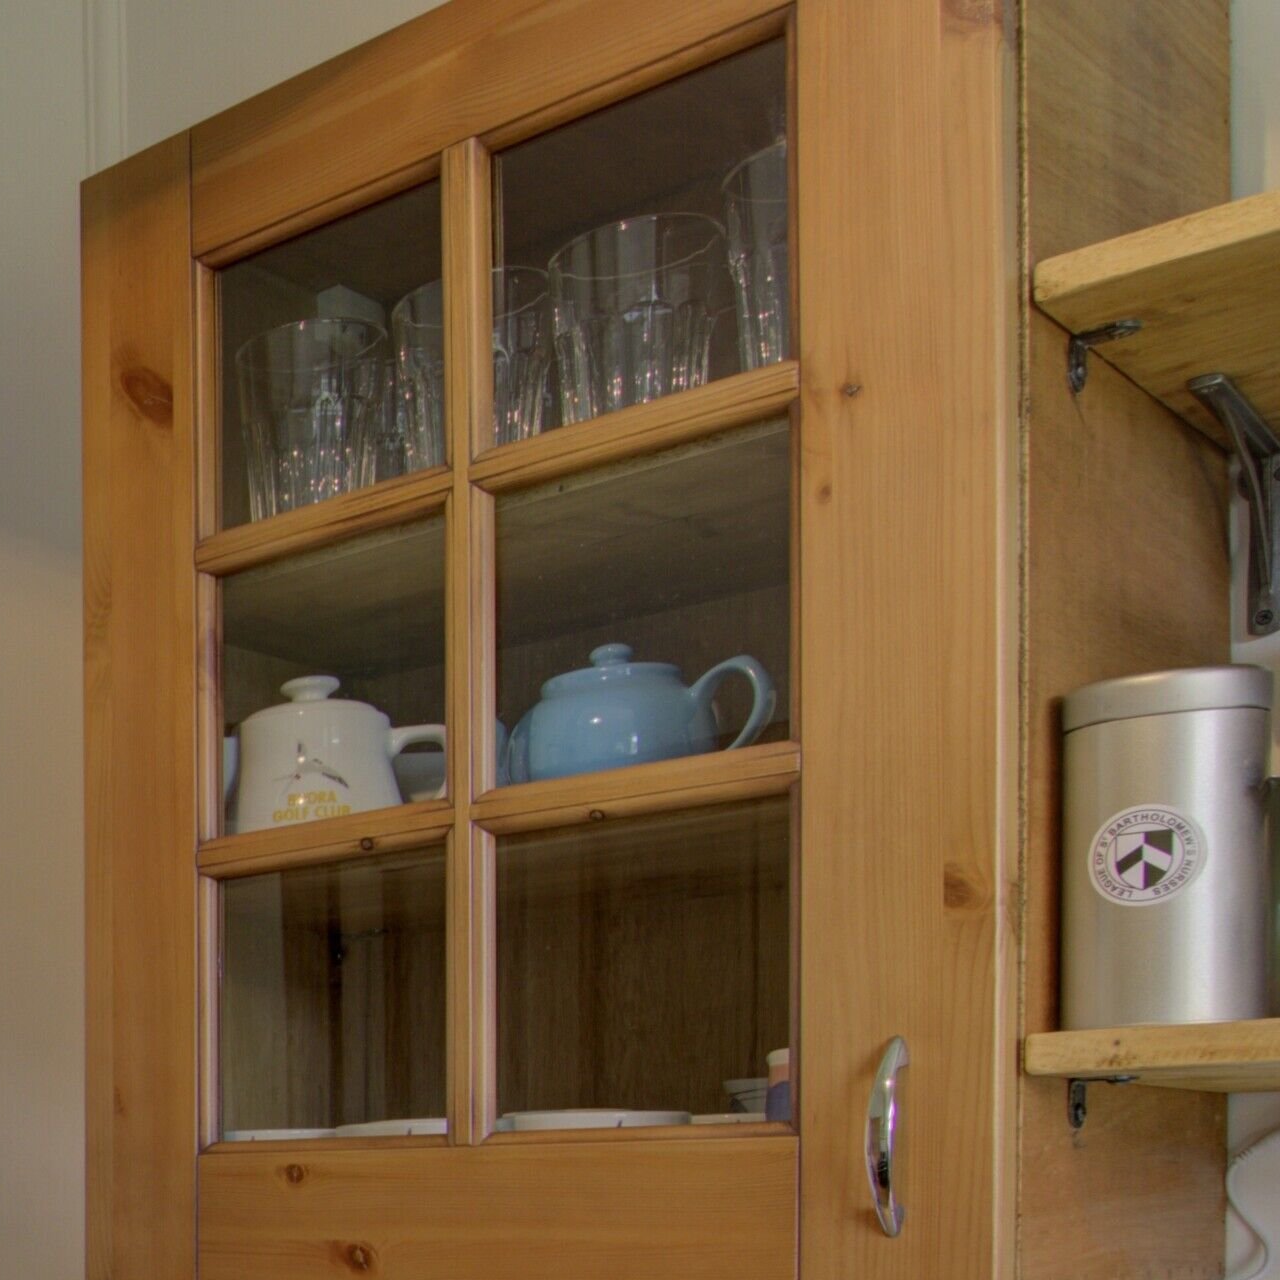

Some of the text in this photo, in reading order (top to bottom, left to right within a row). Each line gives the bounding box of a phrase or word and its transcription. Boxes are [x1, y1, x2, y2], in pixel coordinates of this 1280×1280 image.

[273, 803, 352, 823] GOLF CLUB
[1095, 852, 1104, 866] OF
[1097, 869, 1133, 898] LEAGUE
[1152, 859, 1193, 896] NURSES
